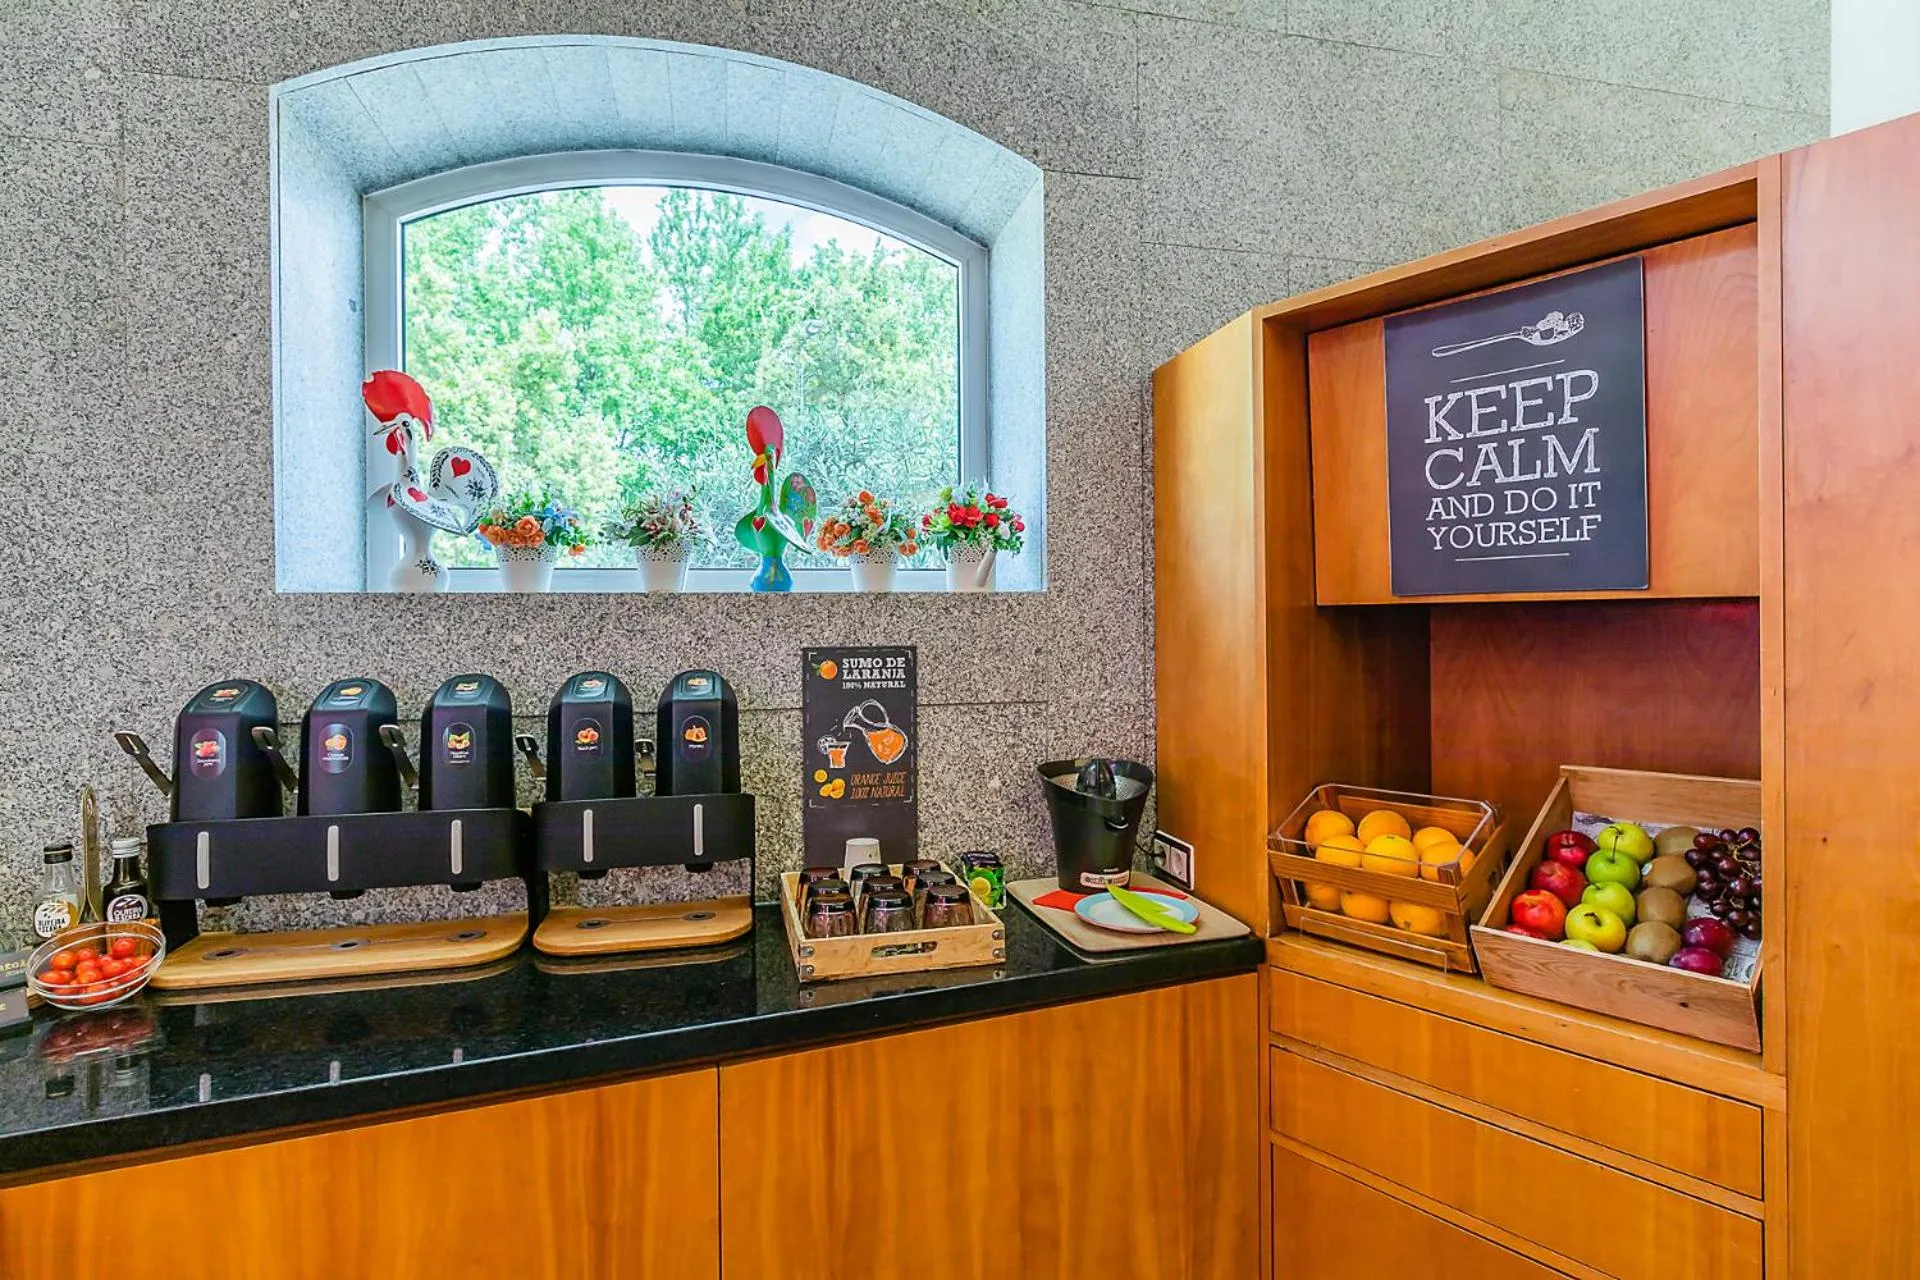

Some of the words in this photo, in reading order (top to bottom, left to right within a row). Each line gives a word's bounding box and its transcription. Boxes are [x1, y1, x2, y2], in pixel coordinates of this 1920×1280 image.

[1424, 369, 1599, 443] KEEP
[1424, 427, 1600, 490] CALM
[1426, 493, 1495, 521] AND
[1504, 487, 1557, 515] DO
[1567, 481, 1601, 509] IT
[1427, 514, 1602, 550] YOURSELF
[842, 657, 882, 669] SUMO
[885, 657, 906, 668] DE
[842, 668, 906, 680] LARANJA
[842, 681, 862, 690] 100%
[863, 680, 906, 689] NATURAL
